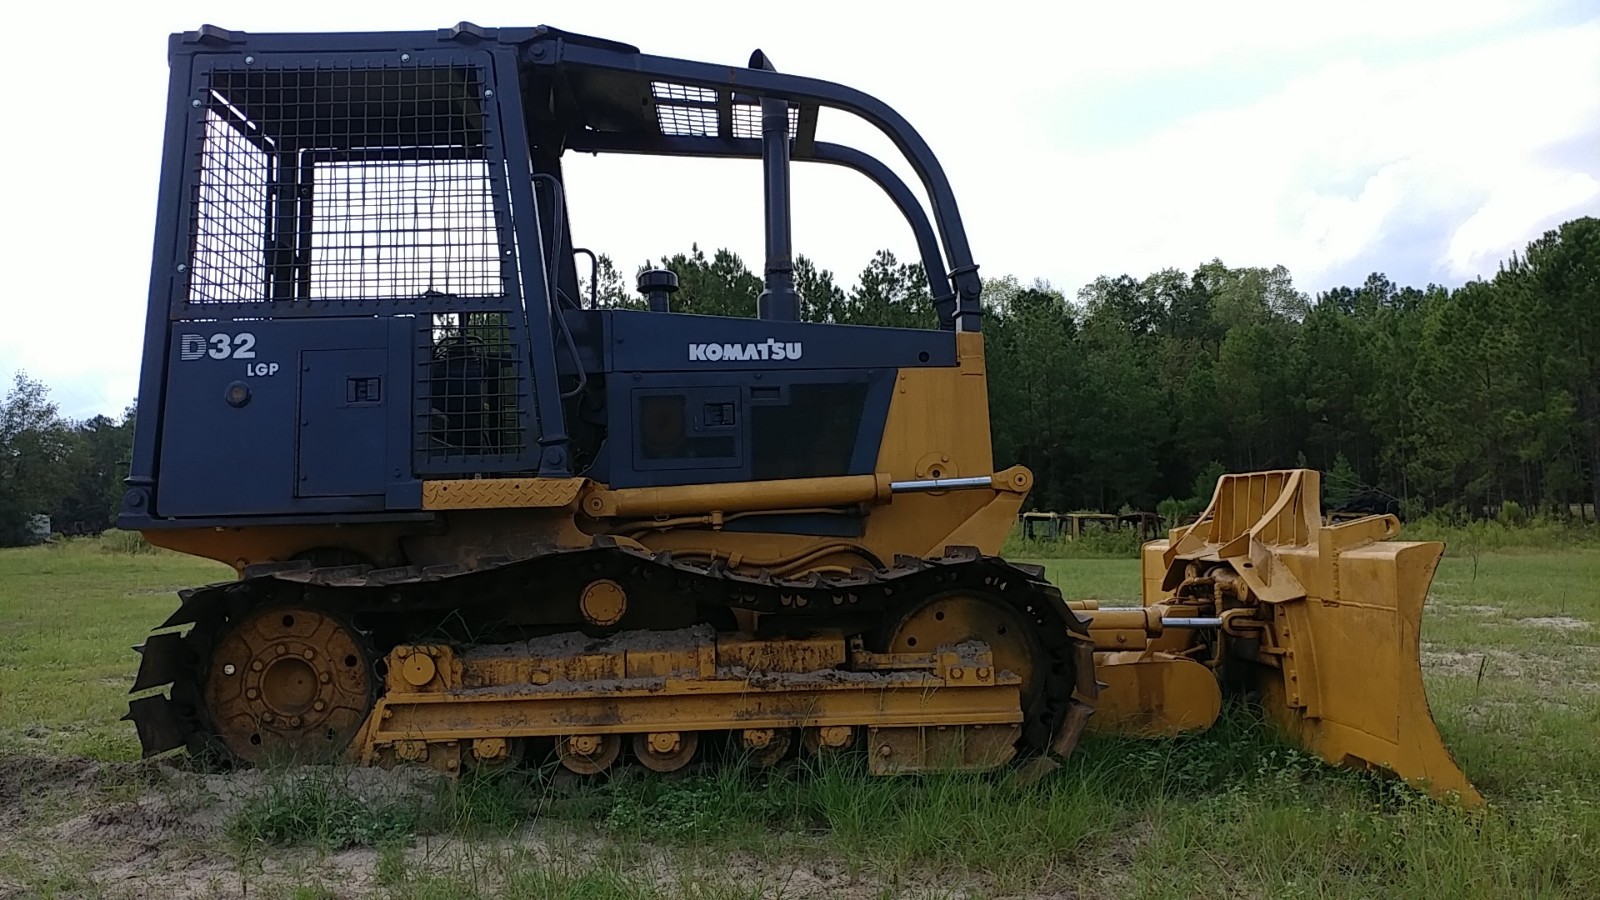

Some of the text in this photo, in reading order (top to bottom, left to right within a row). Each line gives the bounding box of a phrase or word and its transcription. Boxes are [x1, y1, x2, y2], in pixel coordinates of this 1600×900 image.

[180, 332, 256, 360] D32
[688, 338, 803, 361] KOMATSU
[246, 362, 280, 377] LGP
